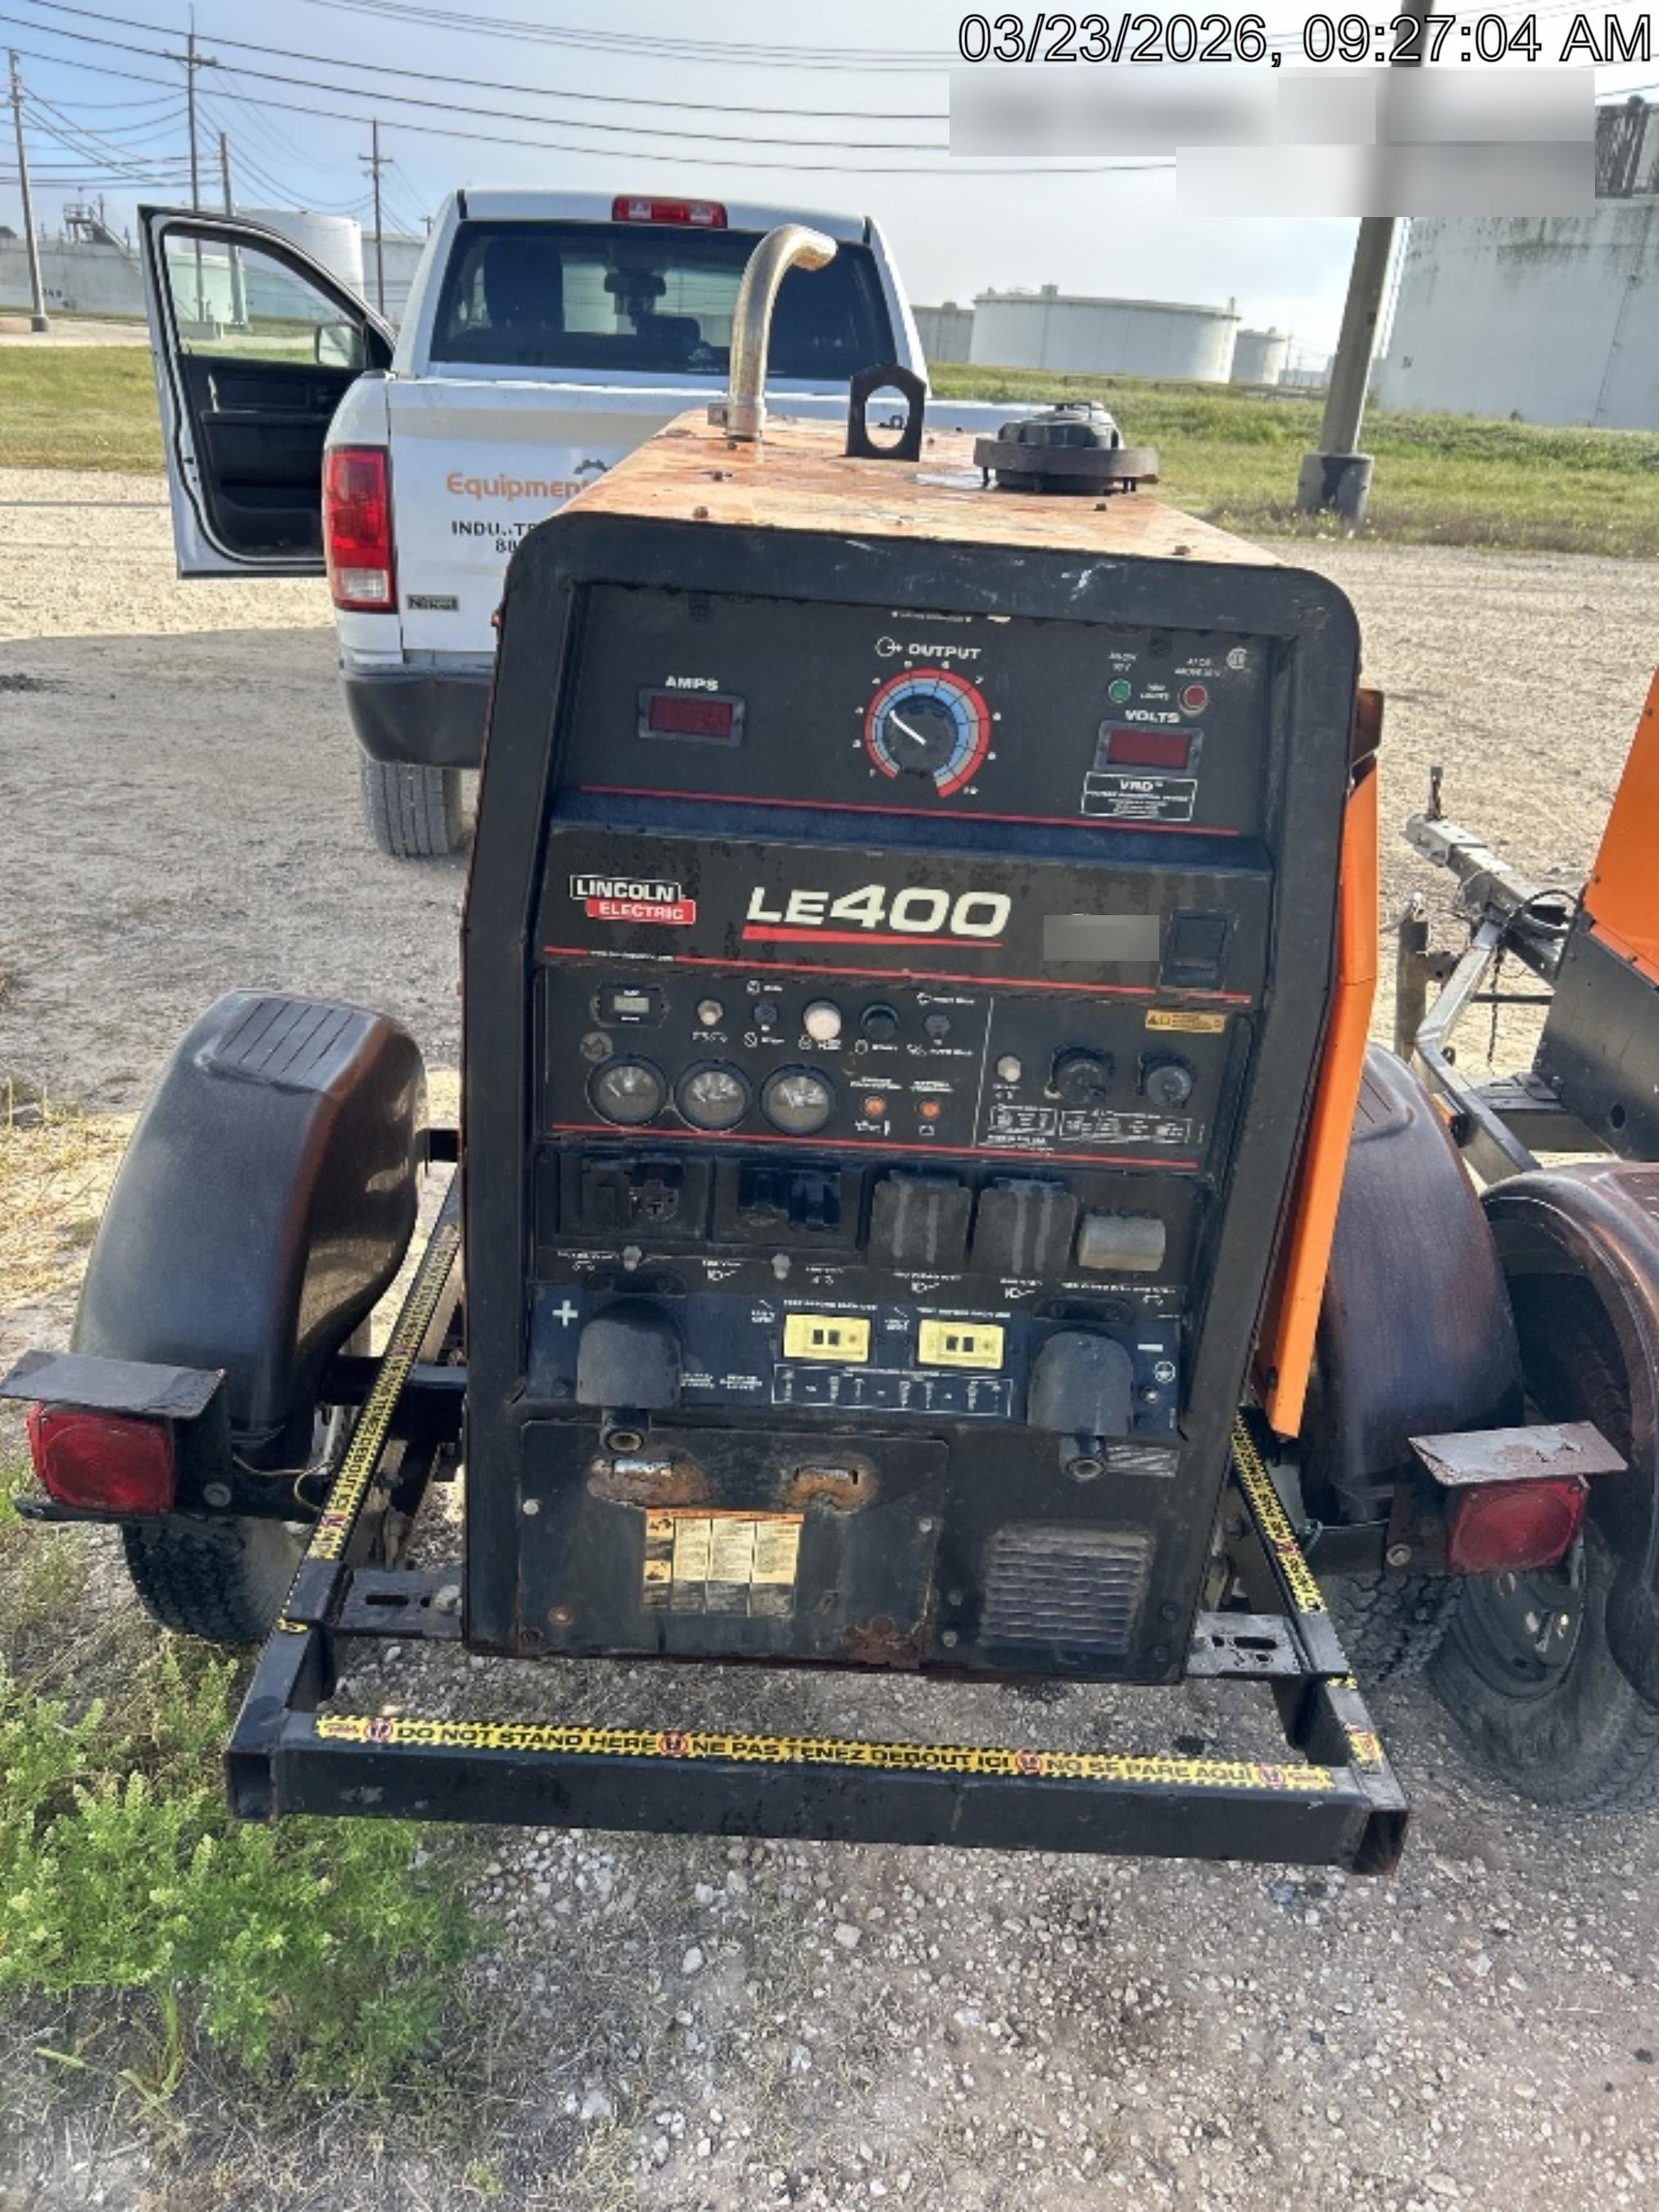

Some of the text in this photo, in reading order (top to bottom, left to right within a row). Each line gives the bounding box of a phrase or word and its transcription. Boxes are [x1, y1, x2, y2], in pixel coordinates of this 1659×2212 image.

[909, 643, 981, 659] OUTPUT
[665, 676, 718, 691] AMPS
[1125, 709, 1180, 723] VOLTS
[576, 879, 674, 902] LINCOLN
[599, 902, 683, 920] ELECTRIC
[746, 884, 1011, 937] LE400
[397, 1727, 657, 1751] DO NOT STAND HERE
[692, 1741, 1009, 1769] NE PAS TENEZ DEBOUT ICI
[1048, 1759, 1082, 1772] NO
[1089, 1761, 1120, 1774] SE
[1127, 1764, 1190, 1778] PARE
